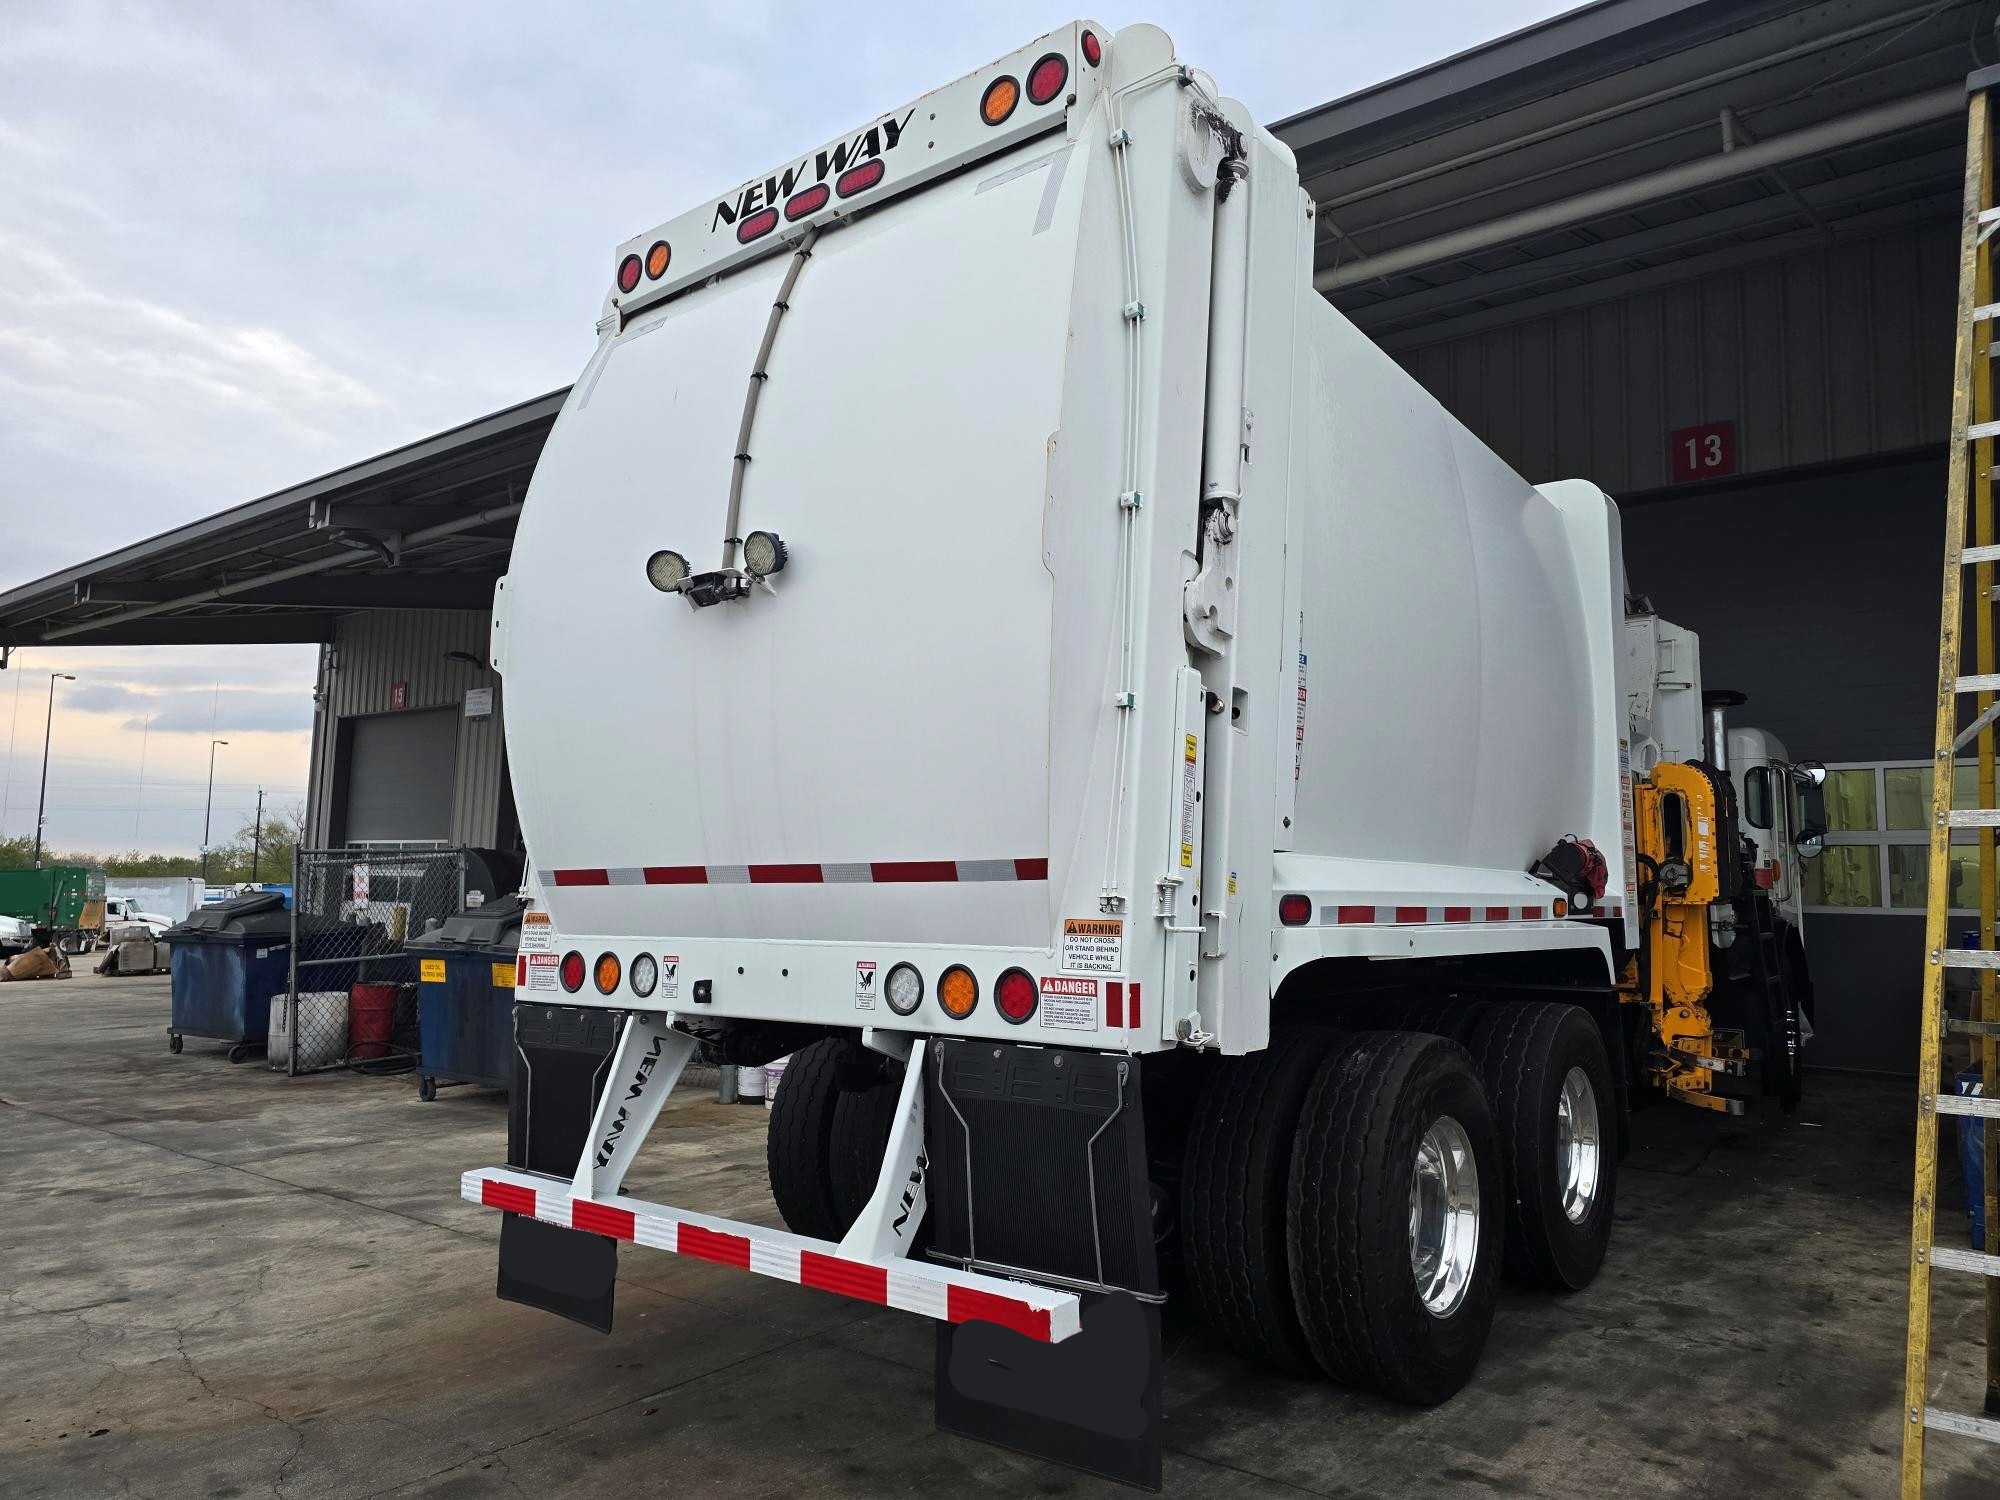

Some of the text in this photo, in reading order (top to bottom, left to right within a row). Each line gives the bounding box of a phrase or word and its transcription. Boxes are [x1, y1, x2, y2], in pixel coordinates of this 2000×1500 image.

[711, 107, 916, 233] NEW WAY
[1684, 434, 1722, 470] 13
[394, 687, 403, 705] 15
[1077, 923, 1120, 935] WARNING
[537, 954, 559, 966] DANGER
[1068, 953, 1115, 962] VEHICLE WHILE
[1054, 980, 1096, 995] DANGER
[593, 1035, 667, 1169] NEW WAY
